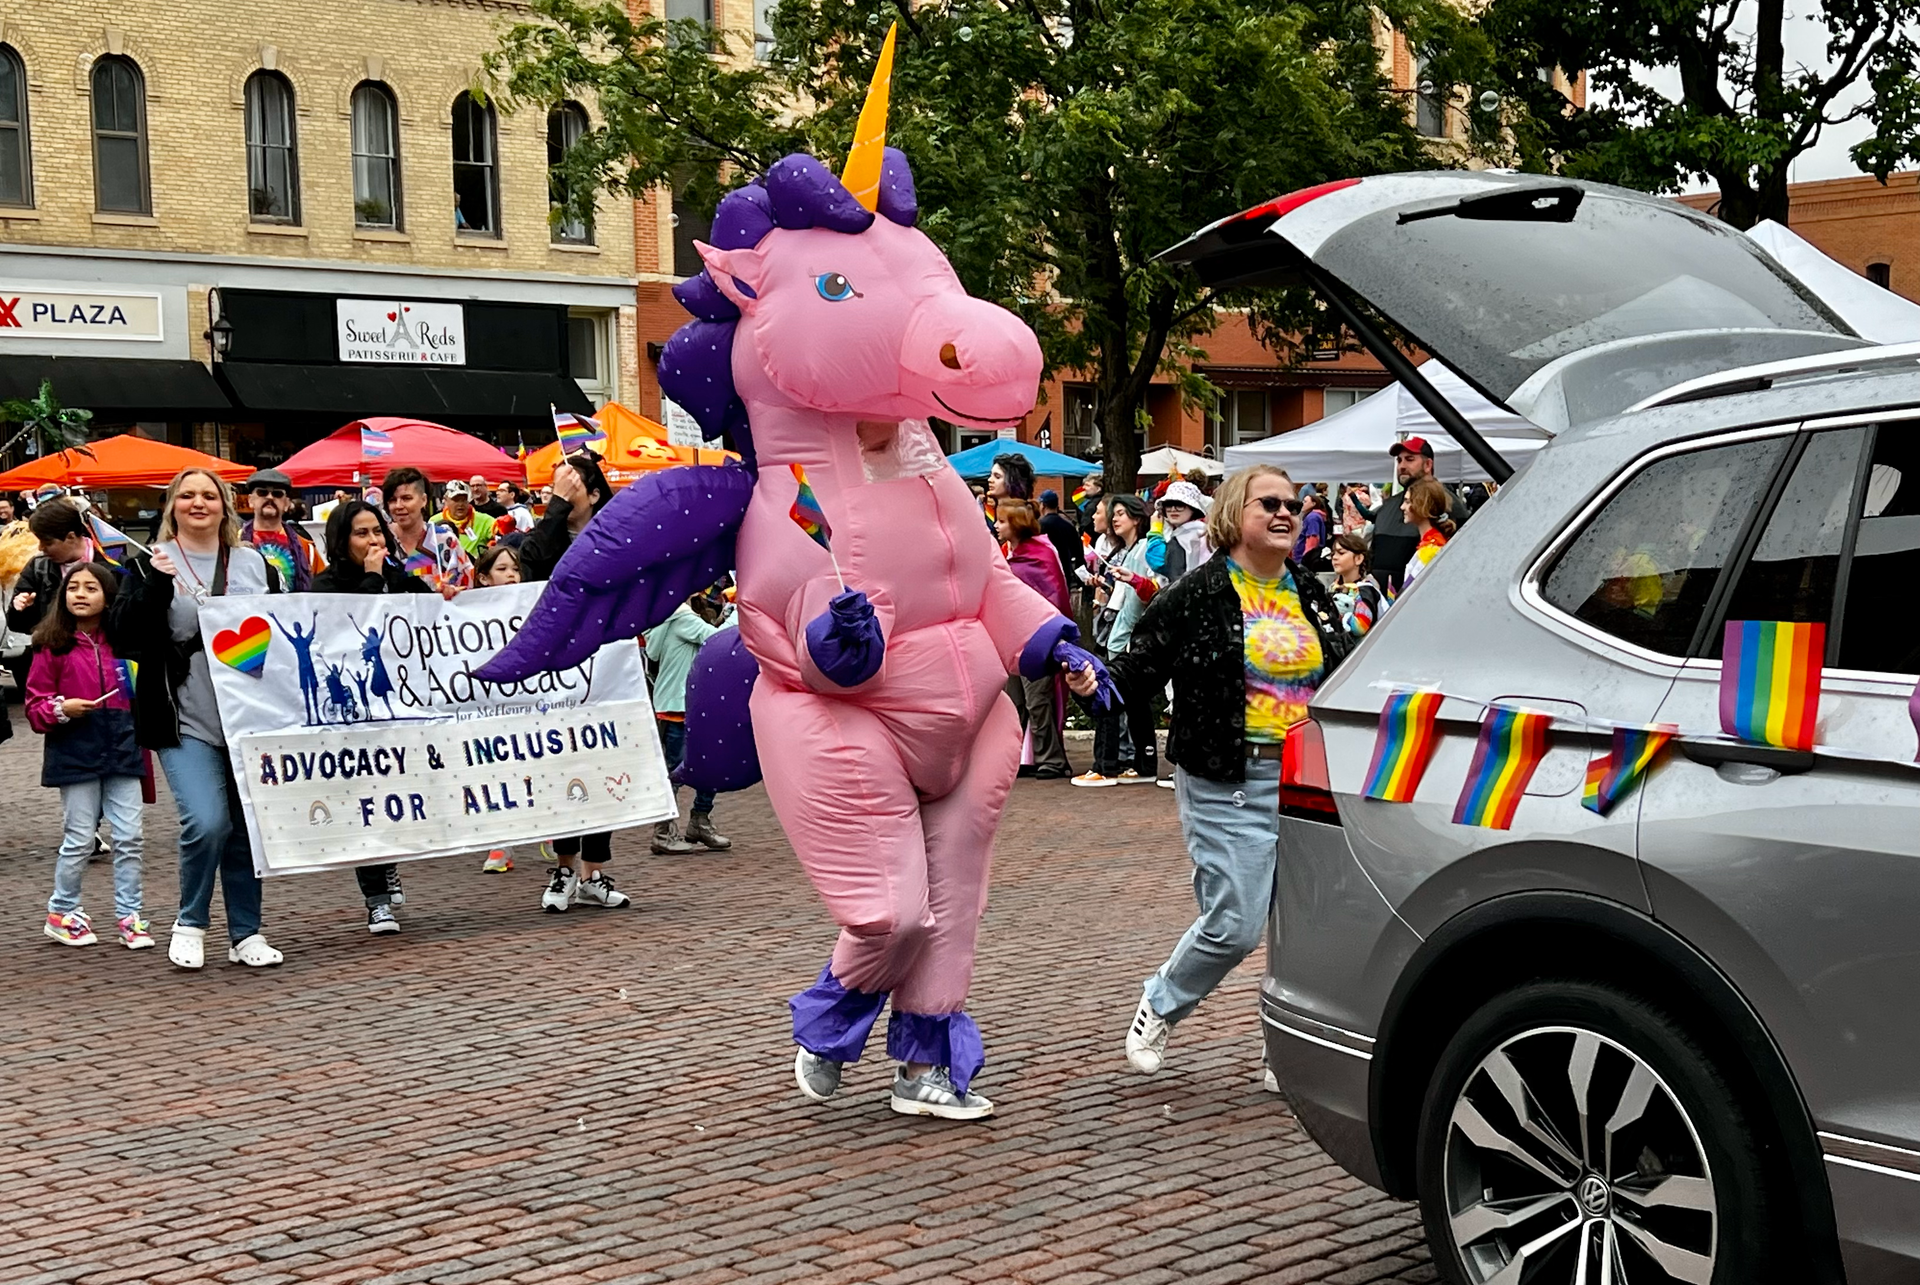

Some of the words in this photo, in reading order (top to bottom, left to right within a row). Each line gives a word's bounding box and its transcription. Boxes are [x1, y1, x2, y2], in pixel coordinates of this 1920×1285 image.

[32, 302, 128, 326] PLAZA
[345, 318, 387, 344] Sweet
[415, 321, 456, 350] Reds
[347, 349, 418, 361] PATISSERIE
[420, 352, 428, 362] &
[430, 352, 458, 363] CAFE
[389, 614, 523, 671] Options
[397, 664, 424, 708] &
[456, 706, 472, 724] for
[477, 702, 532, 719] McHenry
[536, 697, 577, 714] County
[260, 745, 406, 786] ADVOCACY
[426, 743, 445, 770] &
[462, 720, 619, 767] INCLUSION
[358, 793, 427, 827] FOR
[462, 776, 534, 816] ALL!
